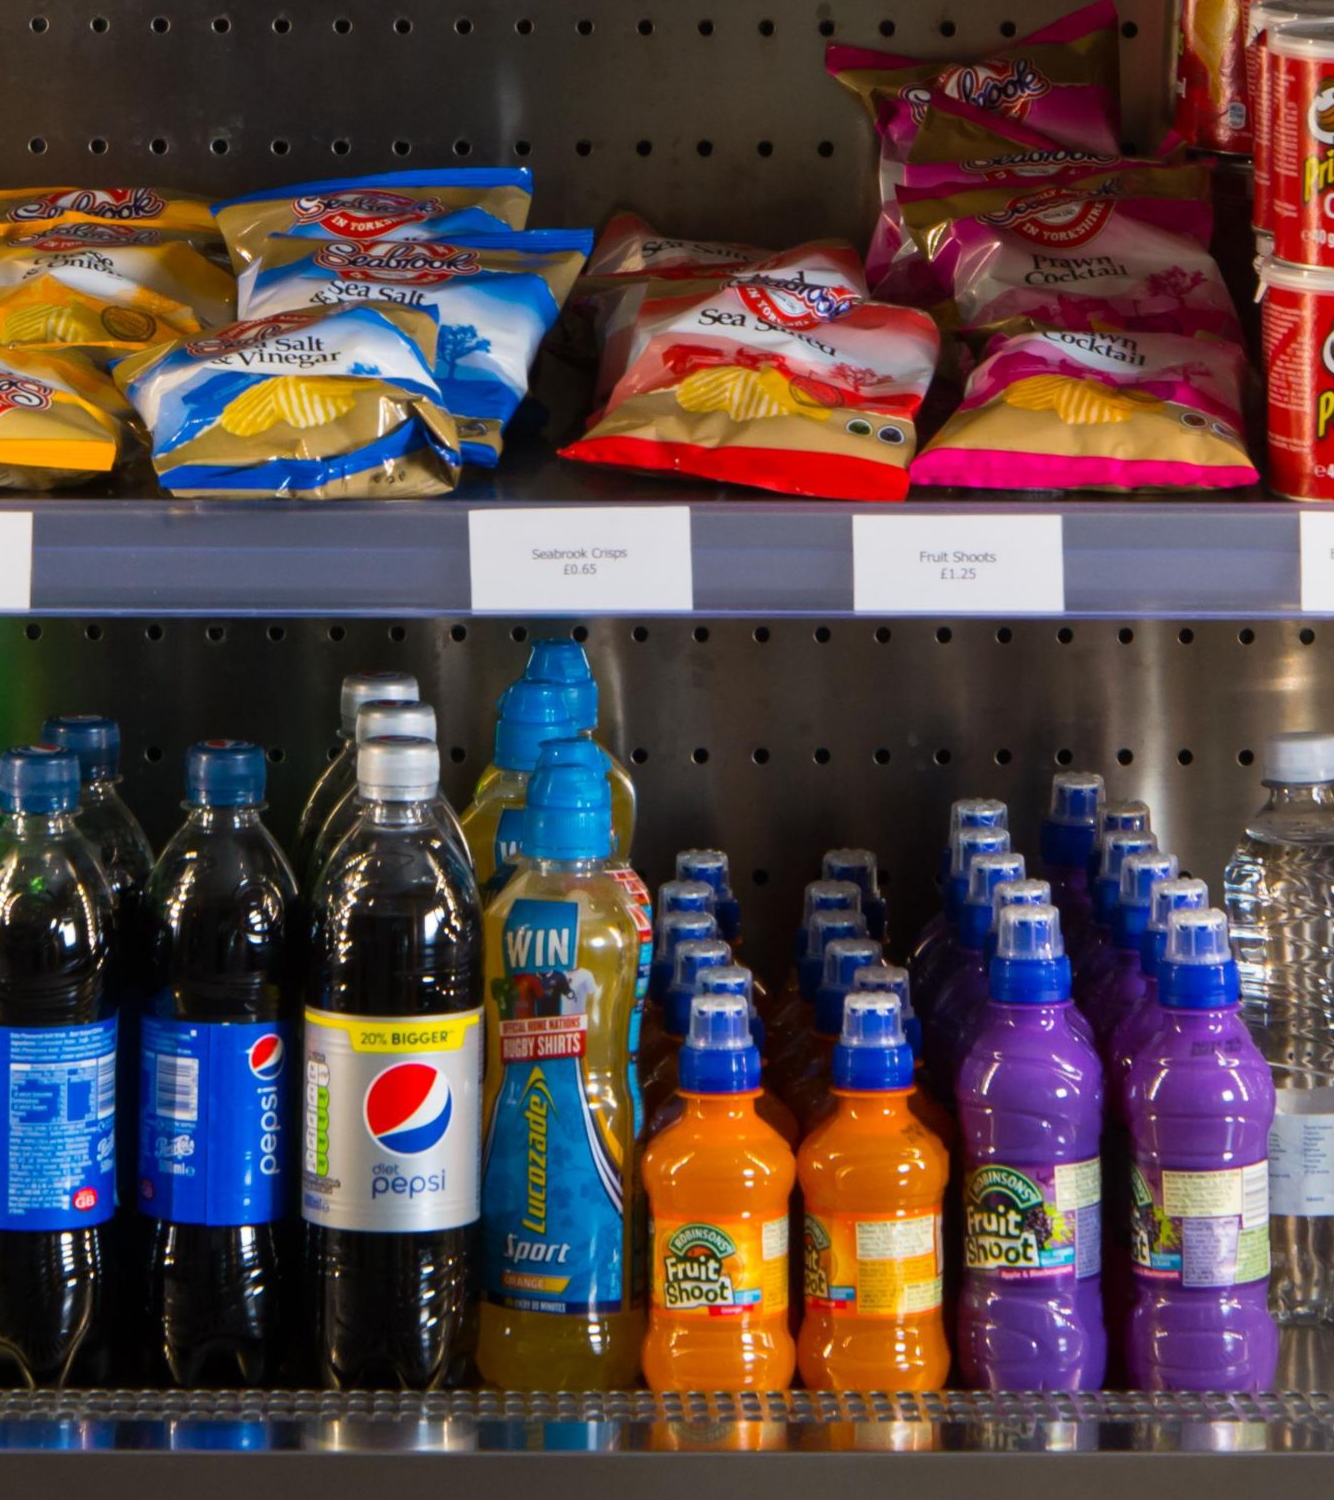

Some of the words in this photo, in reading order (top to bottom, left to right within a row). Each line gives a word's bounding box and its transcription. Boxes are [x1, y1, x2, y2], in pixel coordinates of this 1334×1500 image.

[1031, 253, 1113, 271] Prawn
[1025, 265, 1128, 287] Cocktail
[329, 278, 372, 299] Sea
[378, 286, 426, 306] Salt
[698, 308, 747, 328] Sea
[277, 336, 325, 353] Salt
[1043, 332, 1146, 368] Cocktail
[237, 348, 342, 370] Vinegar
[532, 548, 588, 560] Seabrook
[592, 547, 628, 562] Crisps
[920, 551, 949, 564] Fruit
[953, 551, 998, 564] Shoots
[563, 564, 598, 576] £0.65
[941, 568, 977, 580] £1.25
[506, 928, 570, 969] WIN
[360, 1031, 388, 1046] 20%
[391, 1030, 449, 1046] BIGGER
[503, 1037, 536, 1058] RUGBY
[538, 1033, 582, 1056] SHIRTS
[257, 1086, 283, 1175] pepsi
[372, 1163, 400, 1175] diet
[522, 1094, 548, 1236] Lucozade
[371, 1172, 446, 1200] pepsi
[966, 1205, 1022, 1237] Fruit
[503, 1233, 571, 1264] Sport
[967, 1237, 1034, 1265] Shoot
[666, 1256, 721, 1281] Fruit
[666, 1277, 730, 1305] Shoot
